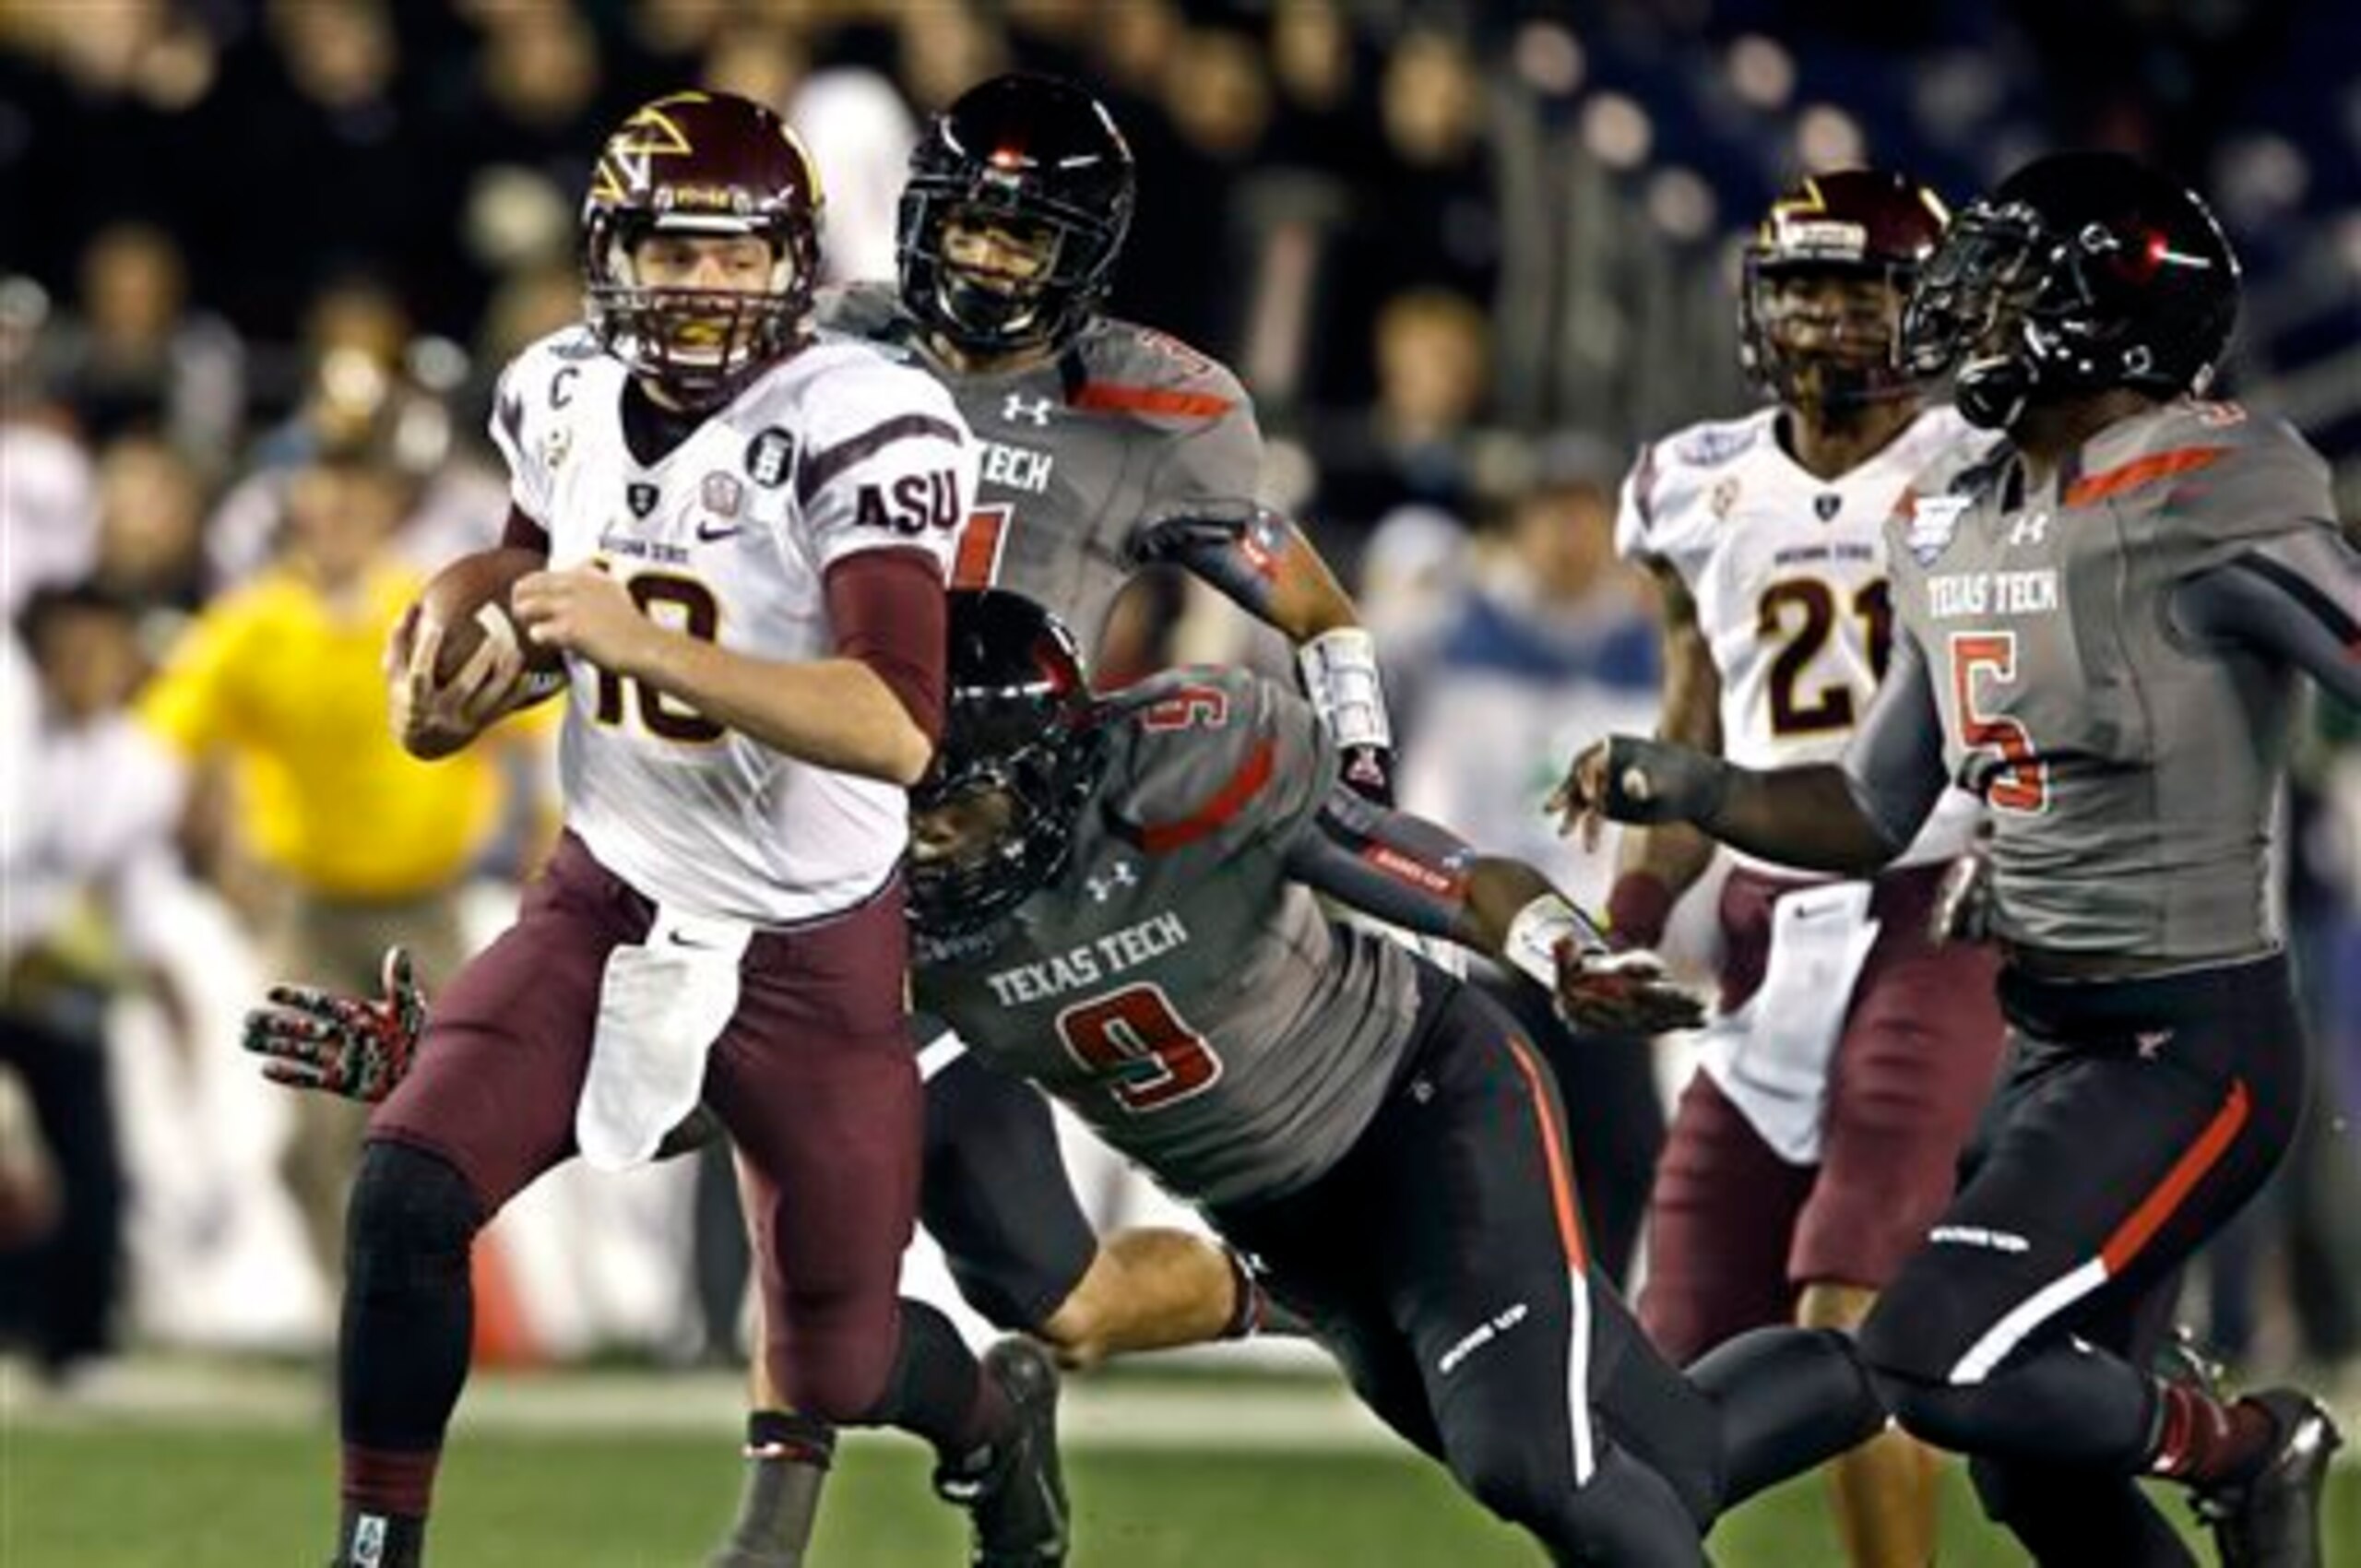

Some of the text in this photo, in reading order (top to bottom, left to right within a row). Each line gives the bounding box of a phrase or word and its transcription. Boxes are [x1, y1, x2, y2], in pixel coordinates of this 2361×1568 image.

[854, 471, 960, 534] ASU
[1928, 569, 2058, 618] TEXAS TECH
[1756, 576, 1892, 736] 21
[1949, 631, 2046, 814] 5
[988, 945, 1103, 1007] TEXAS
[1097, 911, 1188, 973] TECH
[1056, 981, 1223, 1112] 9
